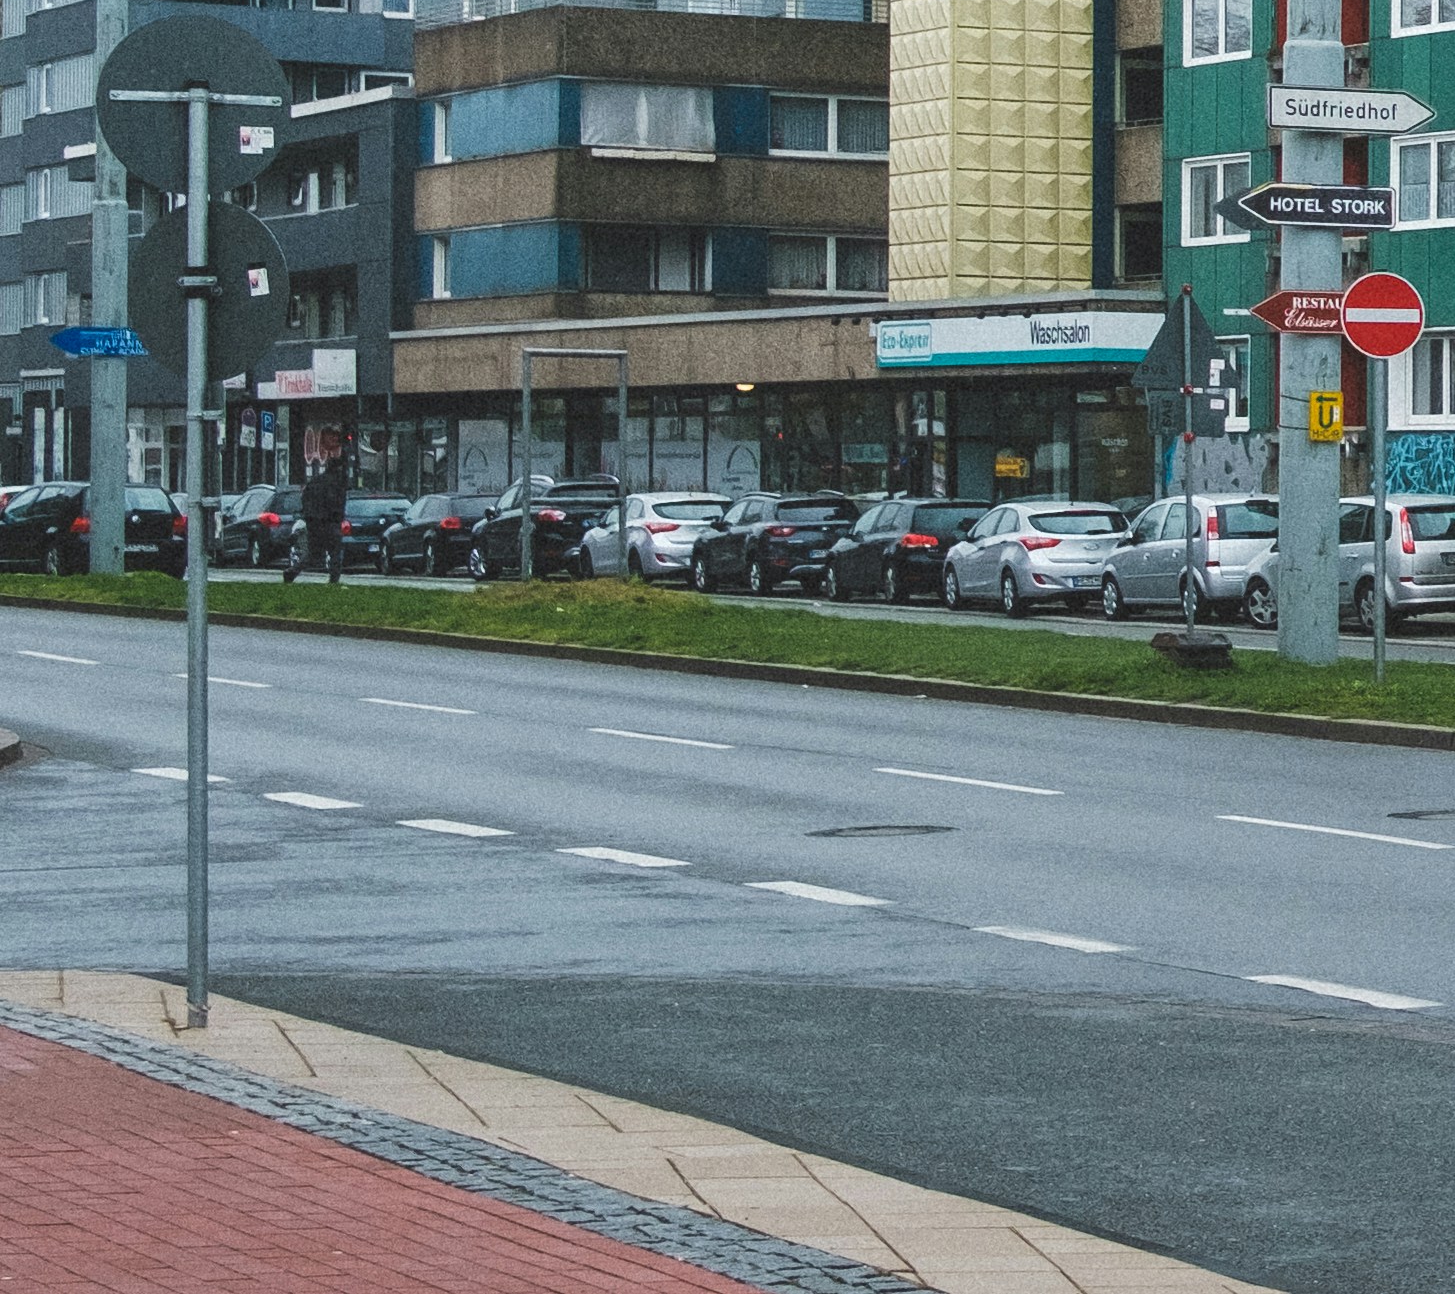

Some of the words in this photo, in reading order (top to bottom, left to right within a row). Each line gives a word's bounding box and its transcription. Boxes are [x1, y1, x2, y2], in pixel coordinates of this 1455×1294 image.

[1284, 97, 1399, 121] Südfriedhof
[1269, 196, 1324, 214] HOTEL
[1331, 198, 1386, 216] STORK
[1030, 320, 1090, 345] Waschsalon
